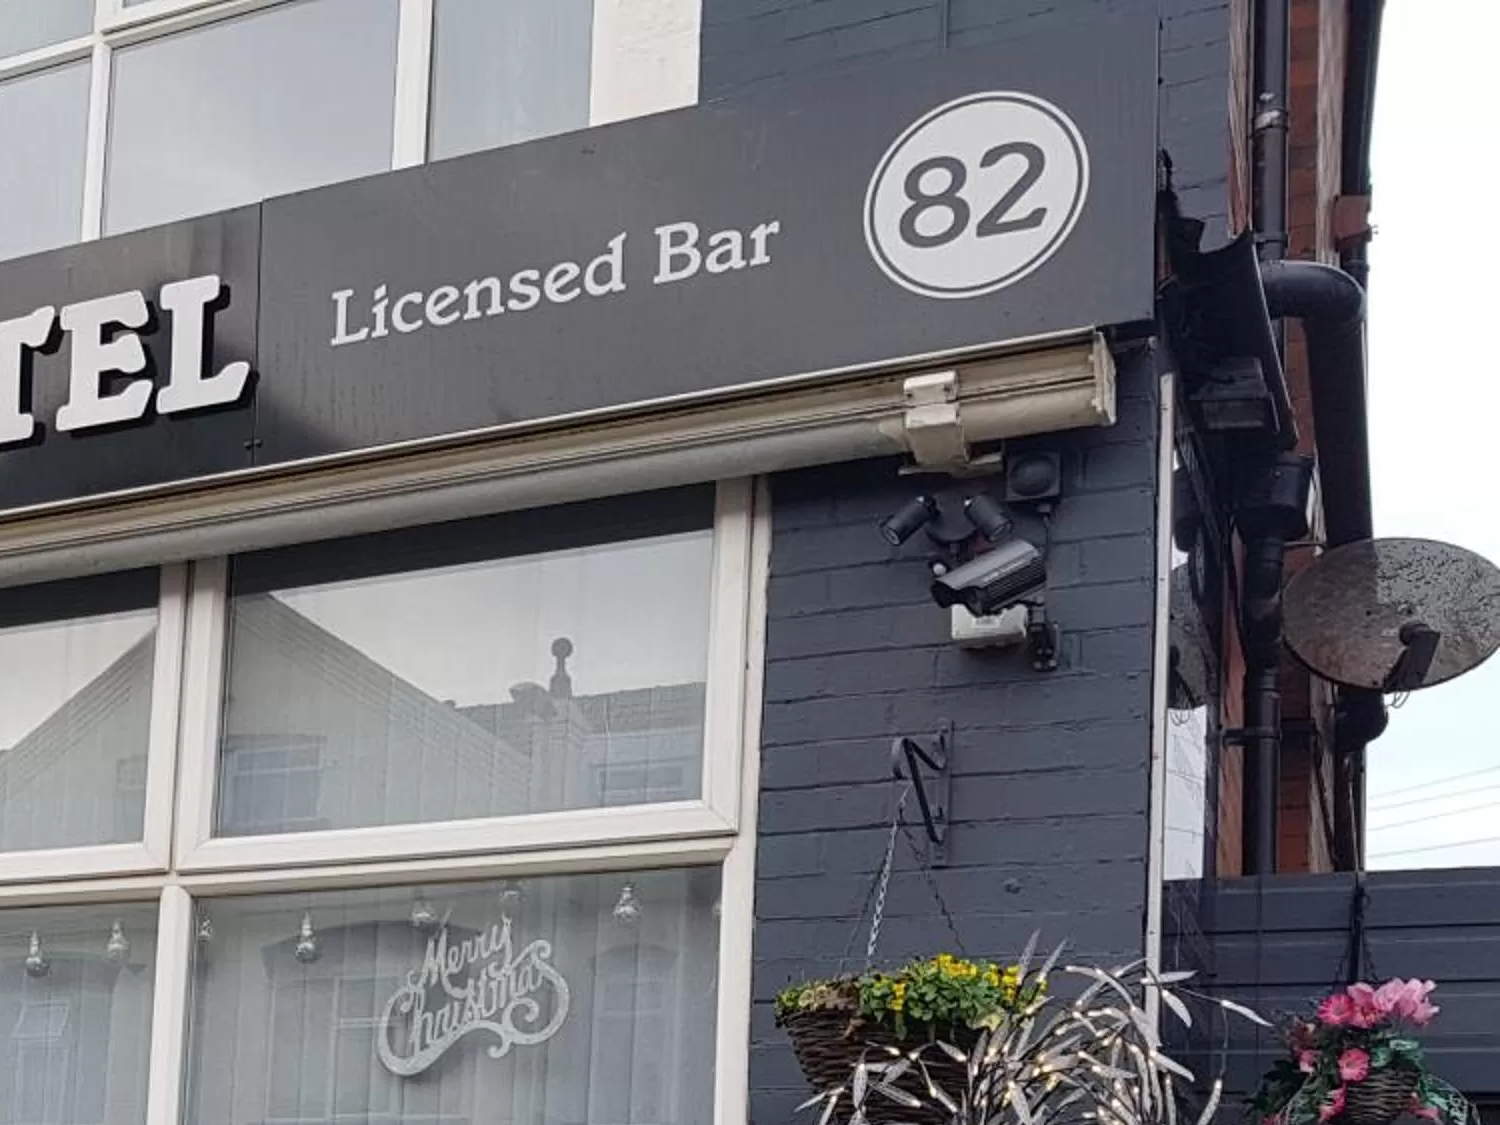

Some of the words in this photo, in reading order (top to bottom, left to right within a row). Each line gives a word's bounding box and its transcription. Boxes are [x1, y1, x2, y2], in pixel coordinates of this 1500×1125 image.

[896, 140, 1049, 251] 82
[328, 232, 627, 347] Licensed
[652, 218, 781, 285] Bar
[406, 912, 512, 987] Merry
